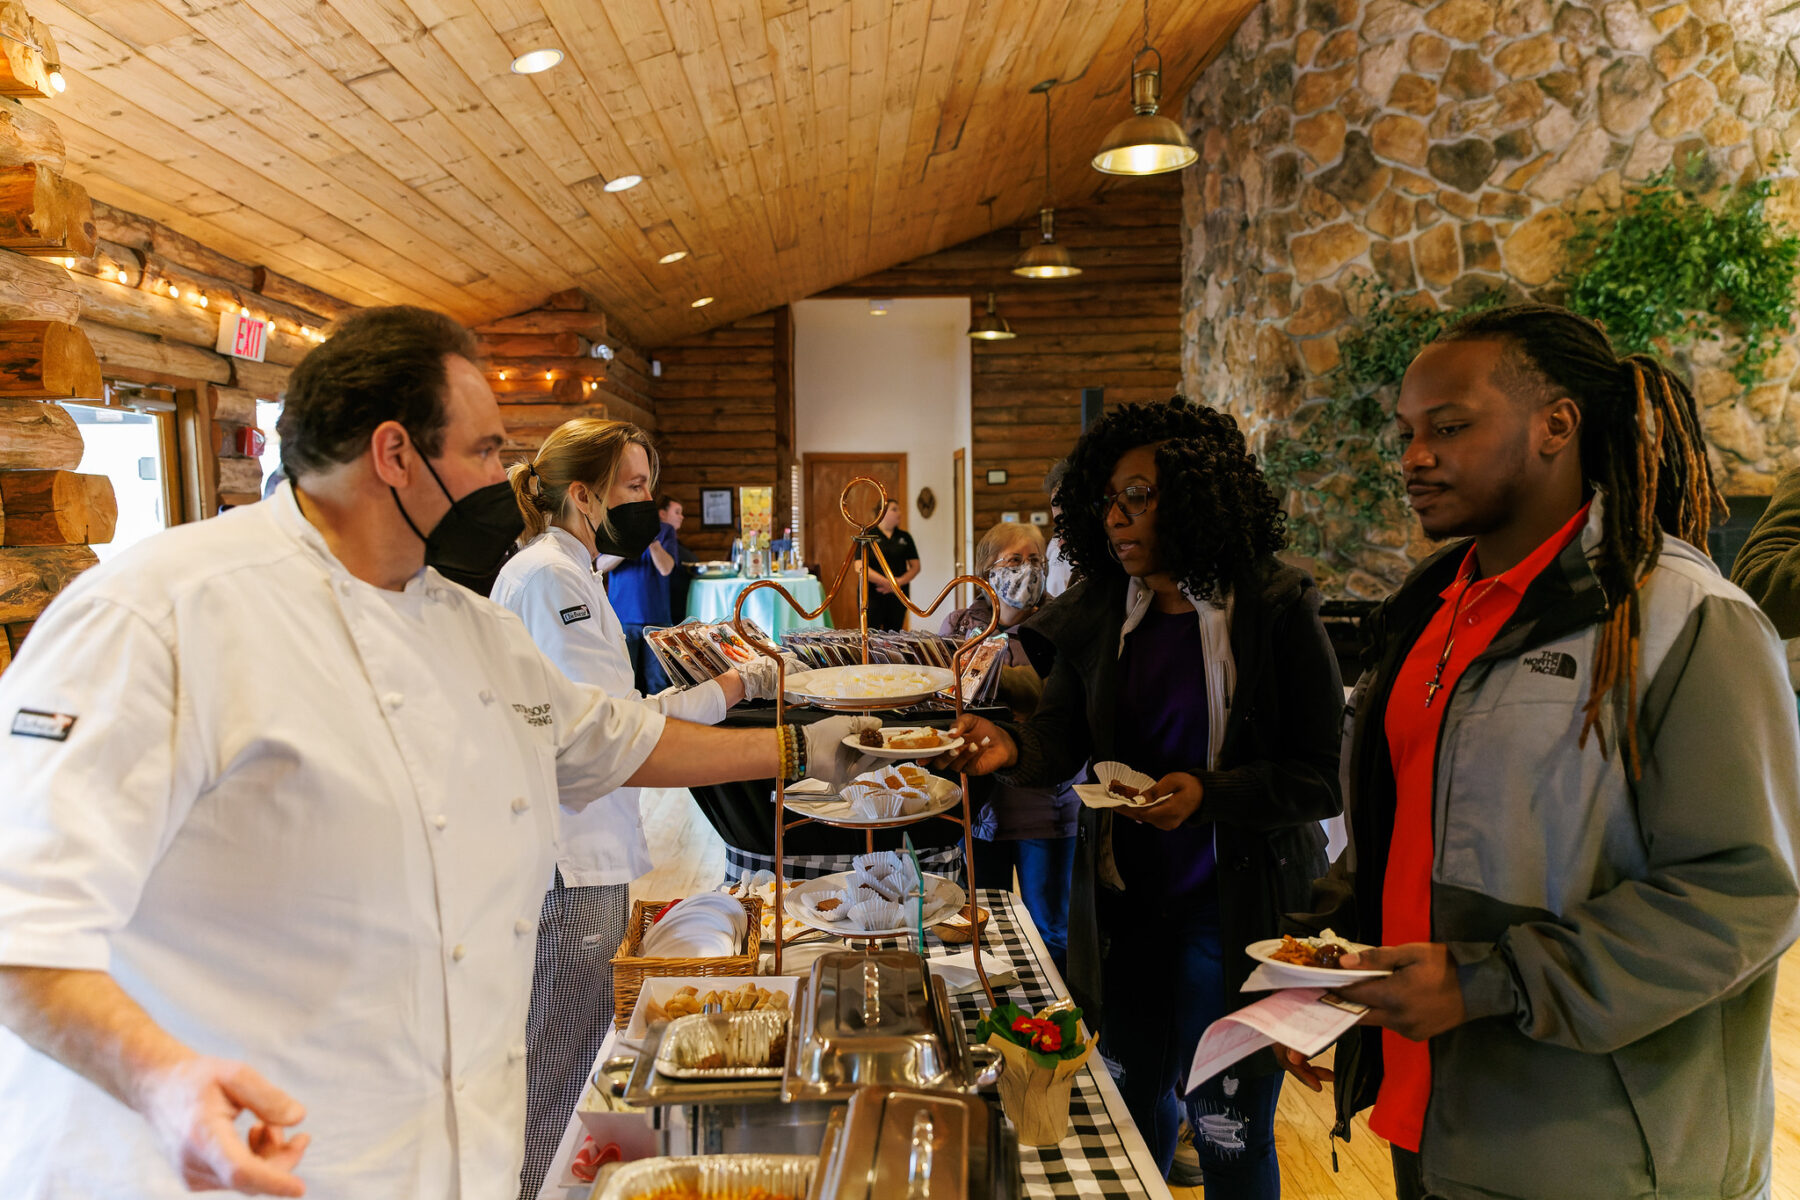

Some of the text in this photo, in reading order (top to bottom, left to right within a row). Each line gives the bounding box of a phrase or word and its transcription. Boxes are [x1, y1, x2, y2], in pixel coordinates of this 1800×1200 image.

[235, 317, 264, 359] EXIT
[1542, 651, 1560, 659] THE
[1523, 657, 1558, 667] NORTH
[1530, 665, 1557, 675] FACE
